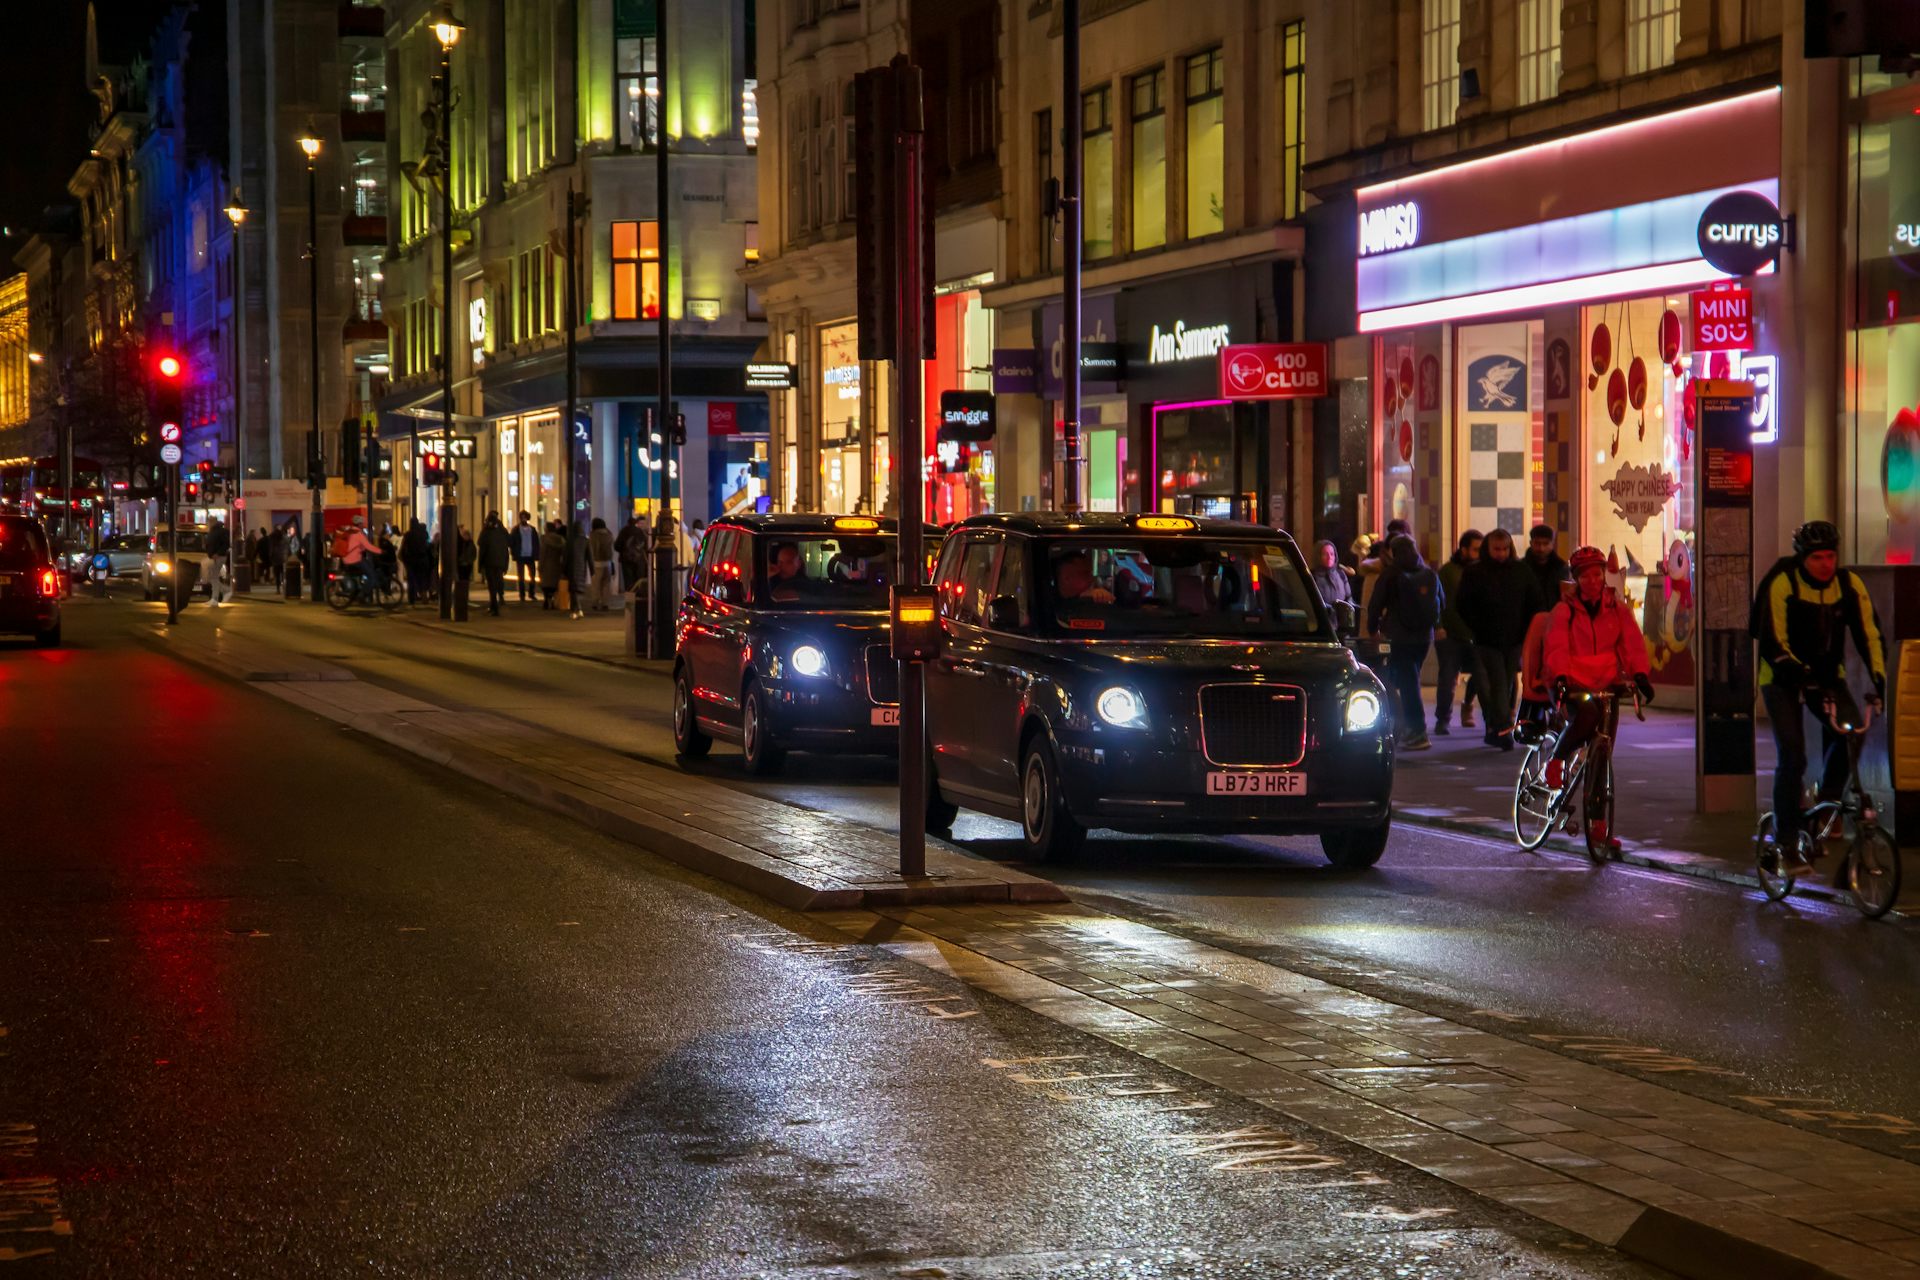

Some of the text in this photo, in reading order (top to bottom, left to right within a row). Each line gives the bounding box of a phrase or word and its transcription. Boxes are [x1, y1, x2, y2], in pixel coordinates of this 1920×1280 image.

[1708, 223, 1779, 248] currys
[1699, 298, 1747, 319] MINI
[1149, 319, 1229, 364] Ann Summers
[1274, 352, 1307, 369] 100
[998, 365, 1034, 377] claire's
[1265, 371, 1319, 388] CLUB
[945, 407, 989, 425] smiggle
[419, 439, 473, 456] NEXT
[1610, 478, 1670, 497] HAPPY CHINESE
[80, 499, 92, 508] 55
[1625, 501, 1655, 514] NEW YEAR
[1142, 519, 1190, 527] TAXI
[1213, 775, 1299, 792] LB73 HRF
